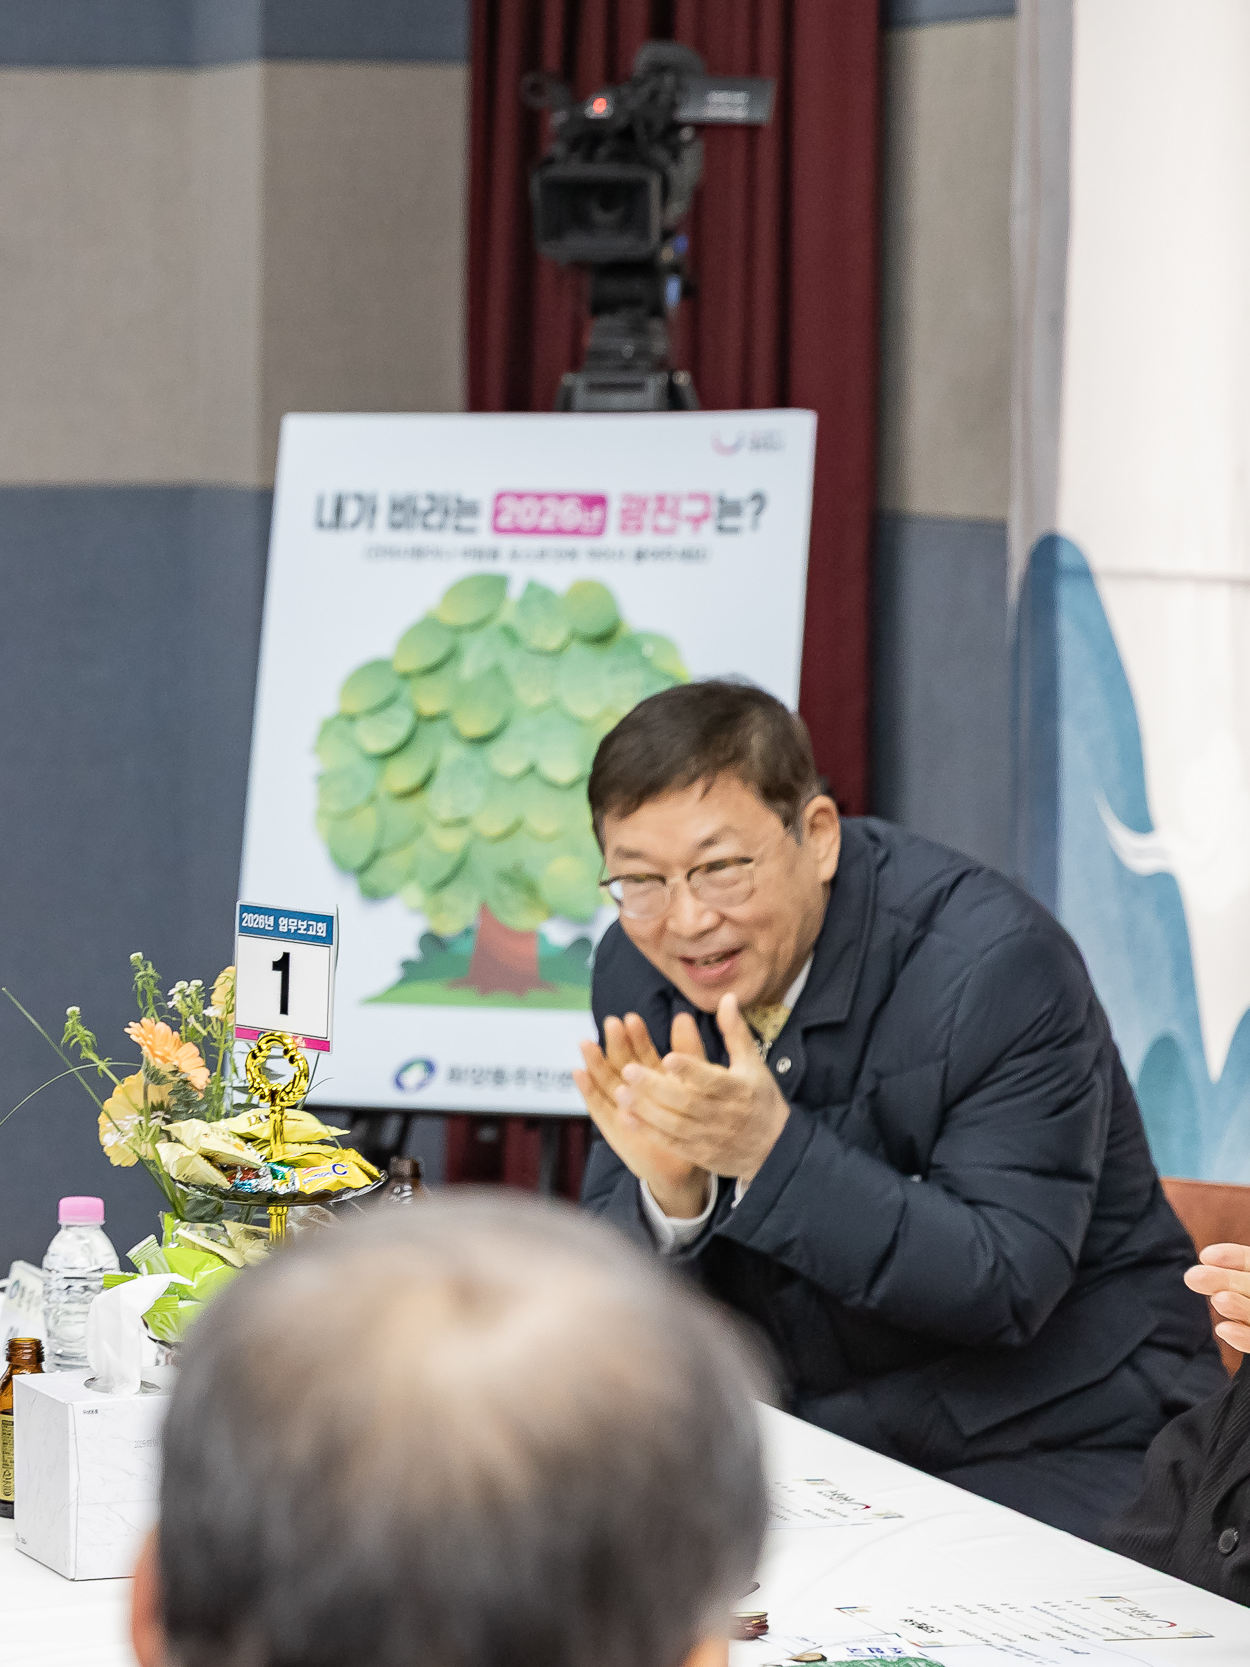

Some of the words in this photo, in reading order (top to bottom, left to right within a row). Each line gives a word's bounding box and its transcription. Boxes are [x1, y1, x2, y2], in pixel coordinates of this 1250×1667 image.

[315, 490, 377, 532] 내가
[387, 491, 481, 533] 바라는
[496, 494, 603, 532] 2026년
[242, 911, 275, 931] 2026년
[278, 916, 327, 938] 업무보고회
[271, 951, 290, 1015] 1
